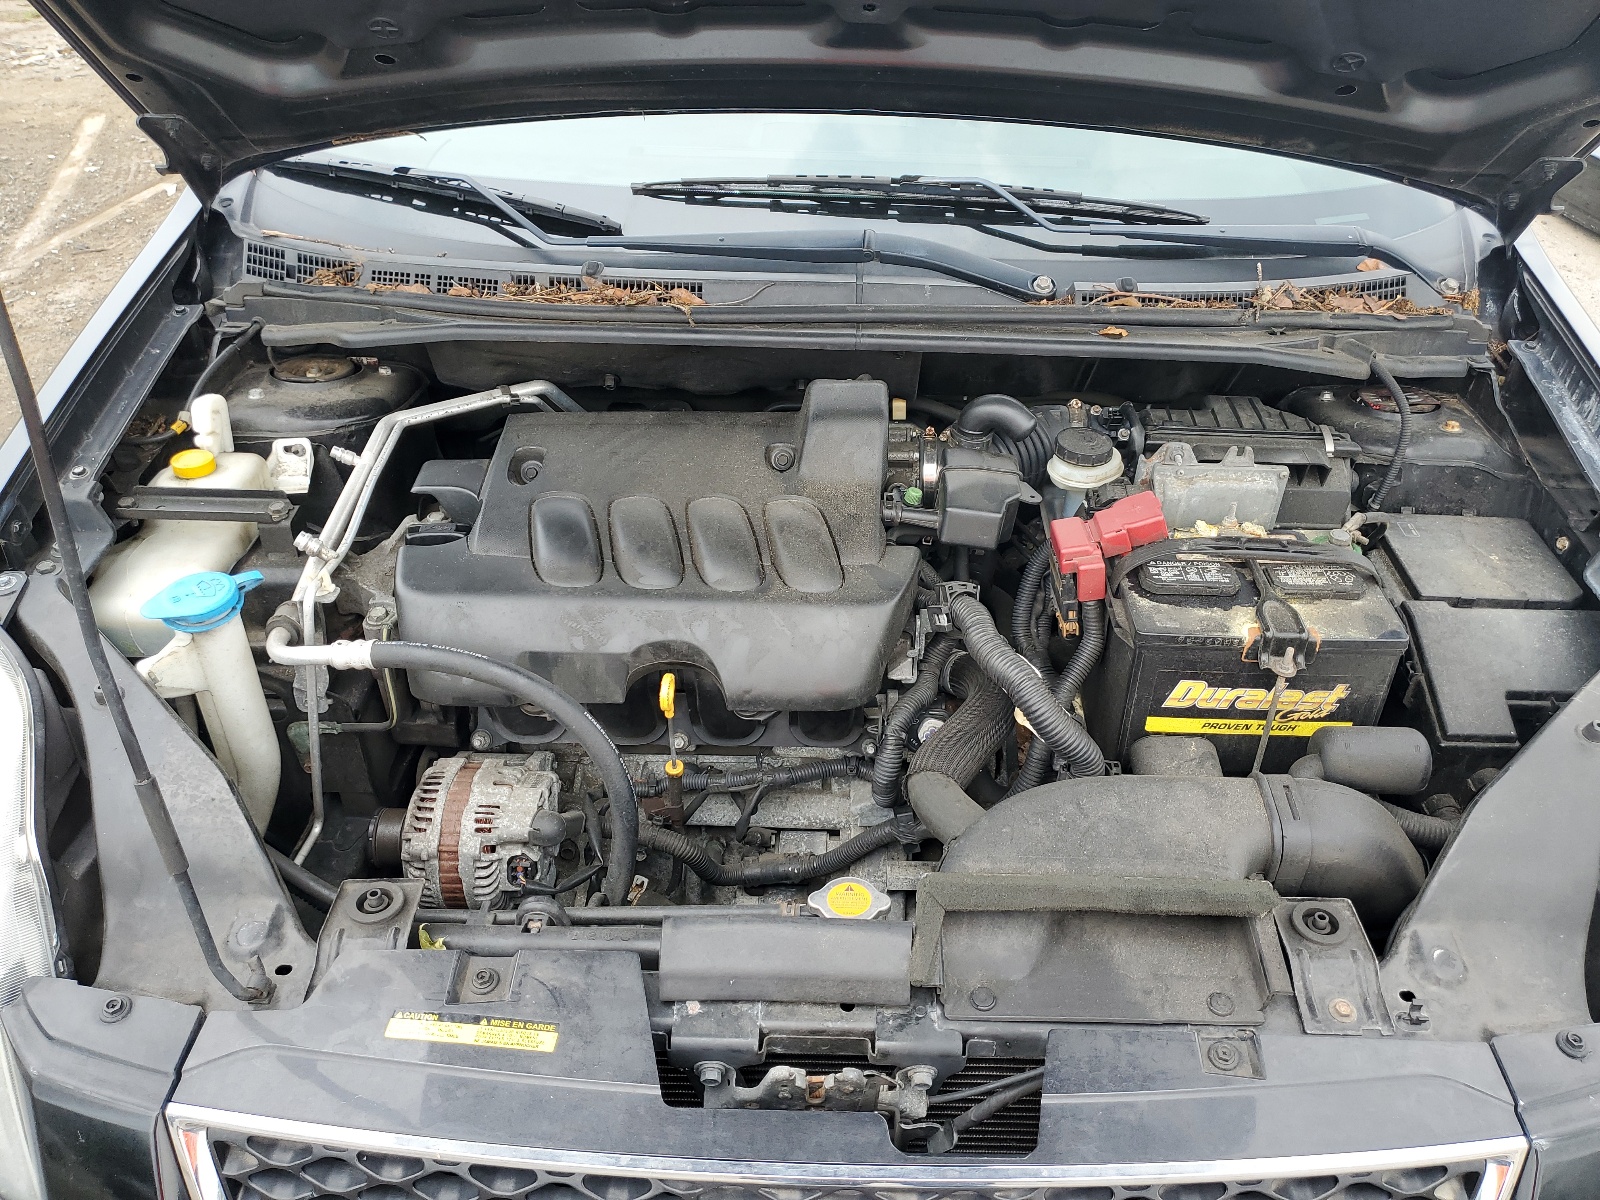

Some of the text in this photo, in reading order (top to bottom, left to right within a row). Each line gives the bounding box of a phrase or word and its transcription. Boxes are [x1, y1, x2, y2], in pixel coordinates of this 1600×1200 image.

[1275, 707, 1332, 723] Gold
[1201, 722, 1297, 732] PROVEN TUGH
[403, 1011, 439, 1021] CAUTION
[490, 1018, 557, 1032] MISE EN GARDE
